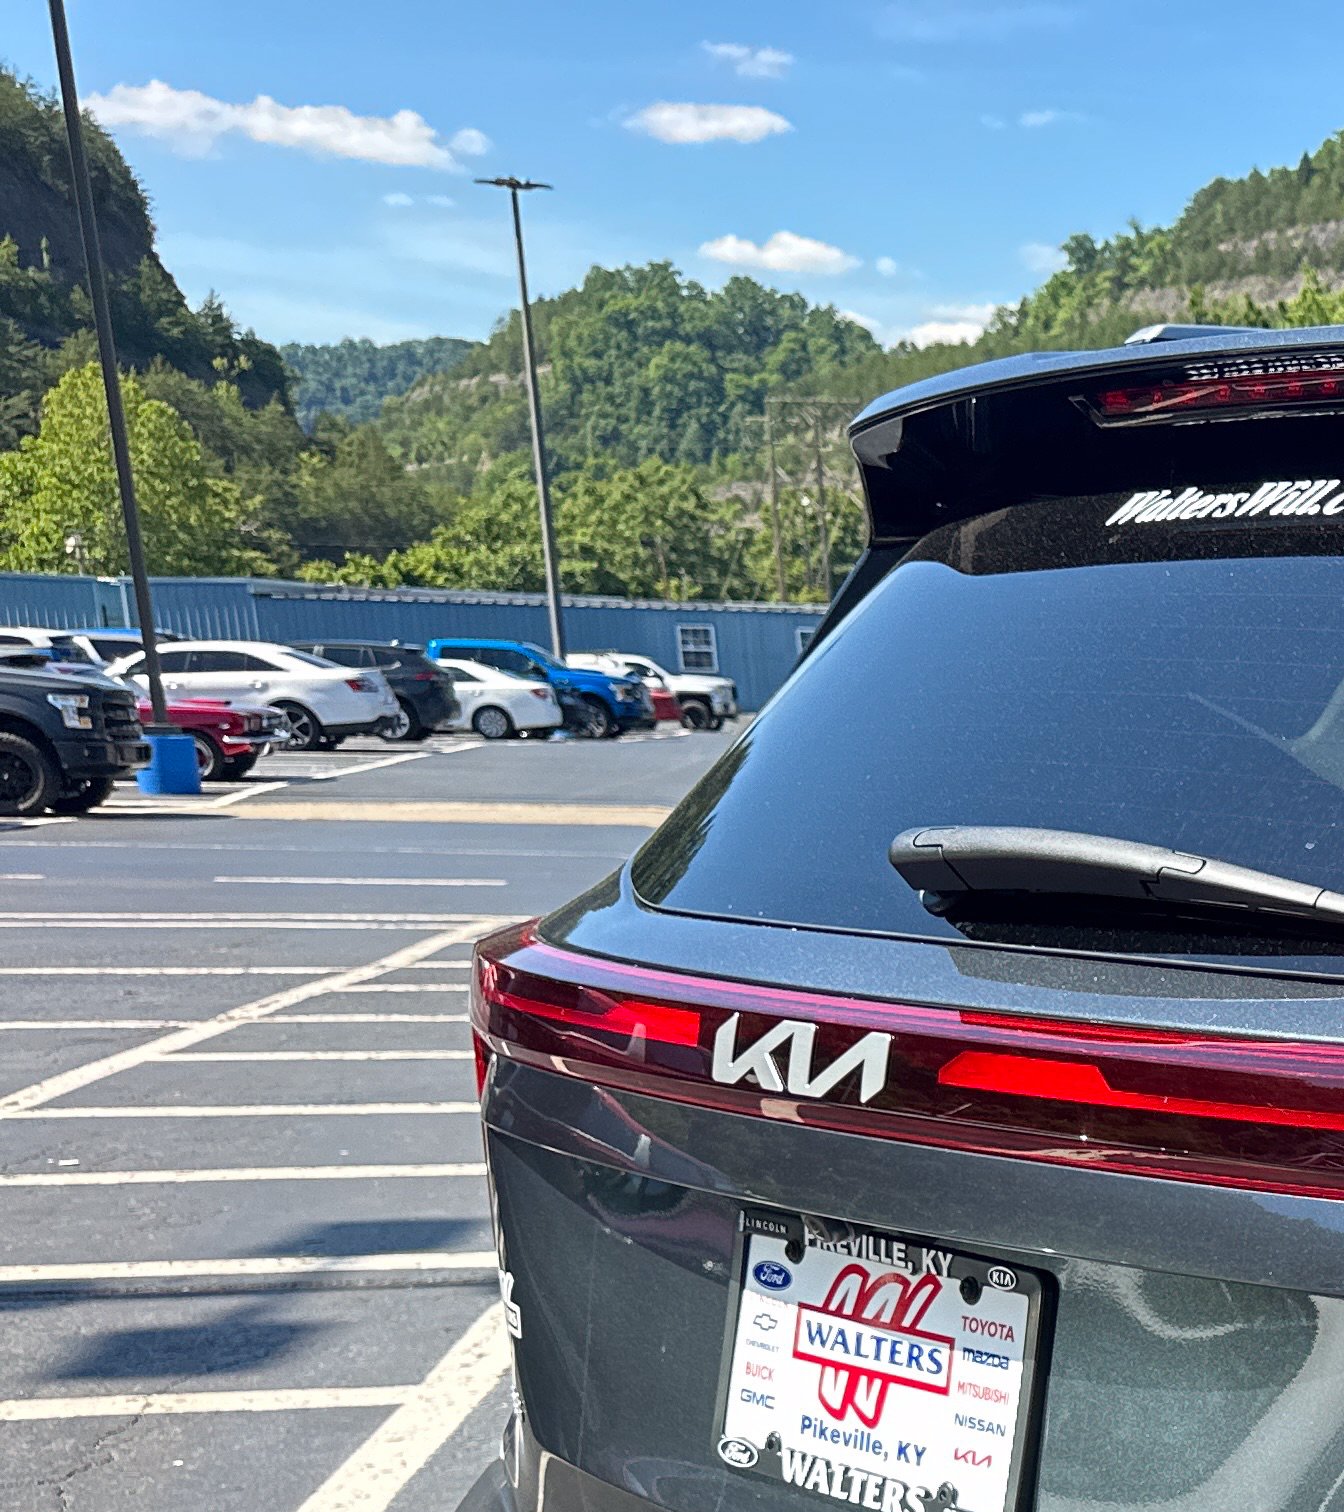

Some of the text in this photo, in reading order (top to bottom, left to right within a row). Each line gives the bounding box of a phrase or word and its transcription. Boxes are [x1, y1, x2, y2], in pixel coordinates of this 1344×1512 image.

[711, 1011, 893, 1104] KIA
[745, 1216, 788, 1235] LINCOLN
[920, 1251, 954, 1279] KY
[960, 1314, 1016, 1343] TOYOTA
[745, 1338, 780, 1354] CHEVROLET
[805, 1319, 944, 1375] WALTERS
[745, 1361, 774, 1383] BUICK
[740, 1387, 776, 1410] GMC
[957, 1379, 1010, 1405] MITSUBISHI
[954, 1412, 1006, 1438] NISSAN
[800, 1413, 928, 1467] Pikeville, KY
[953, 1447, 993, 1468] KIA
